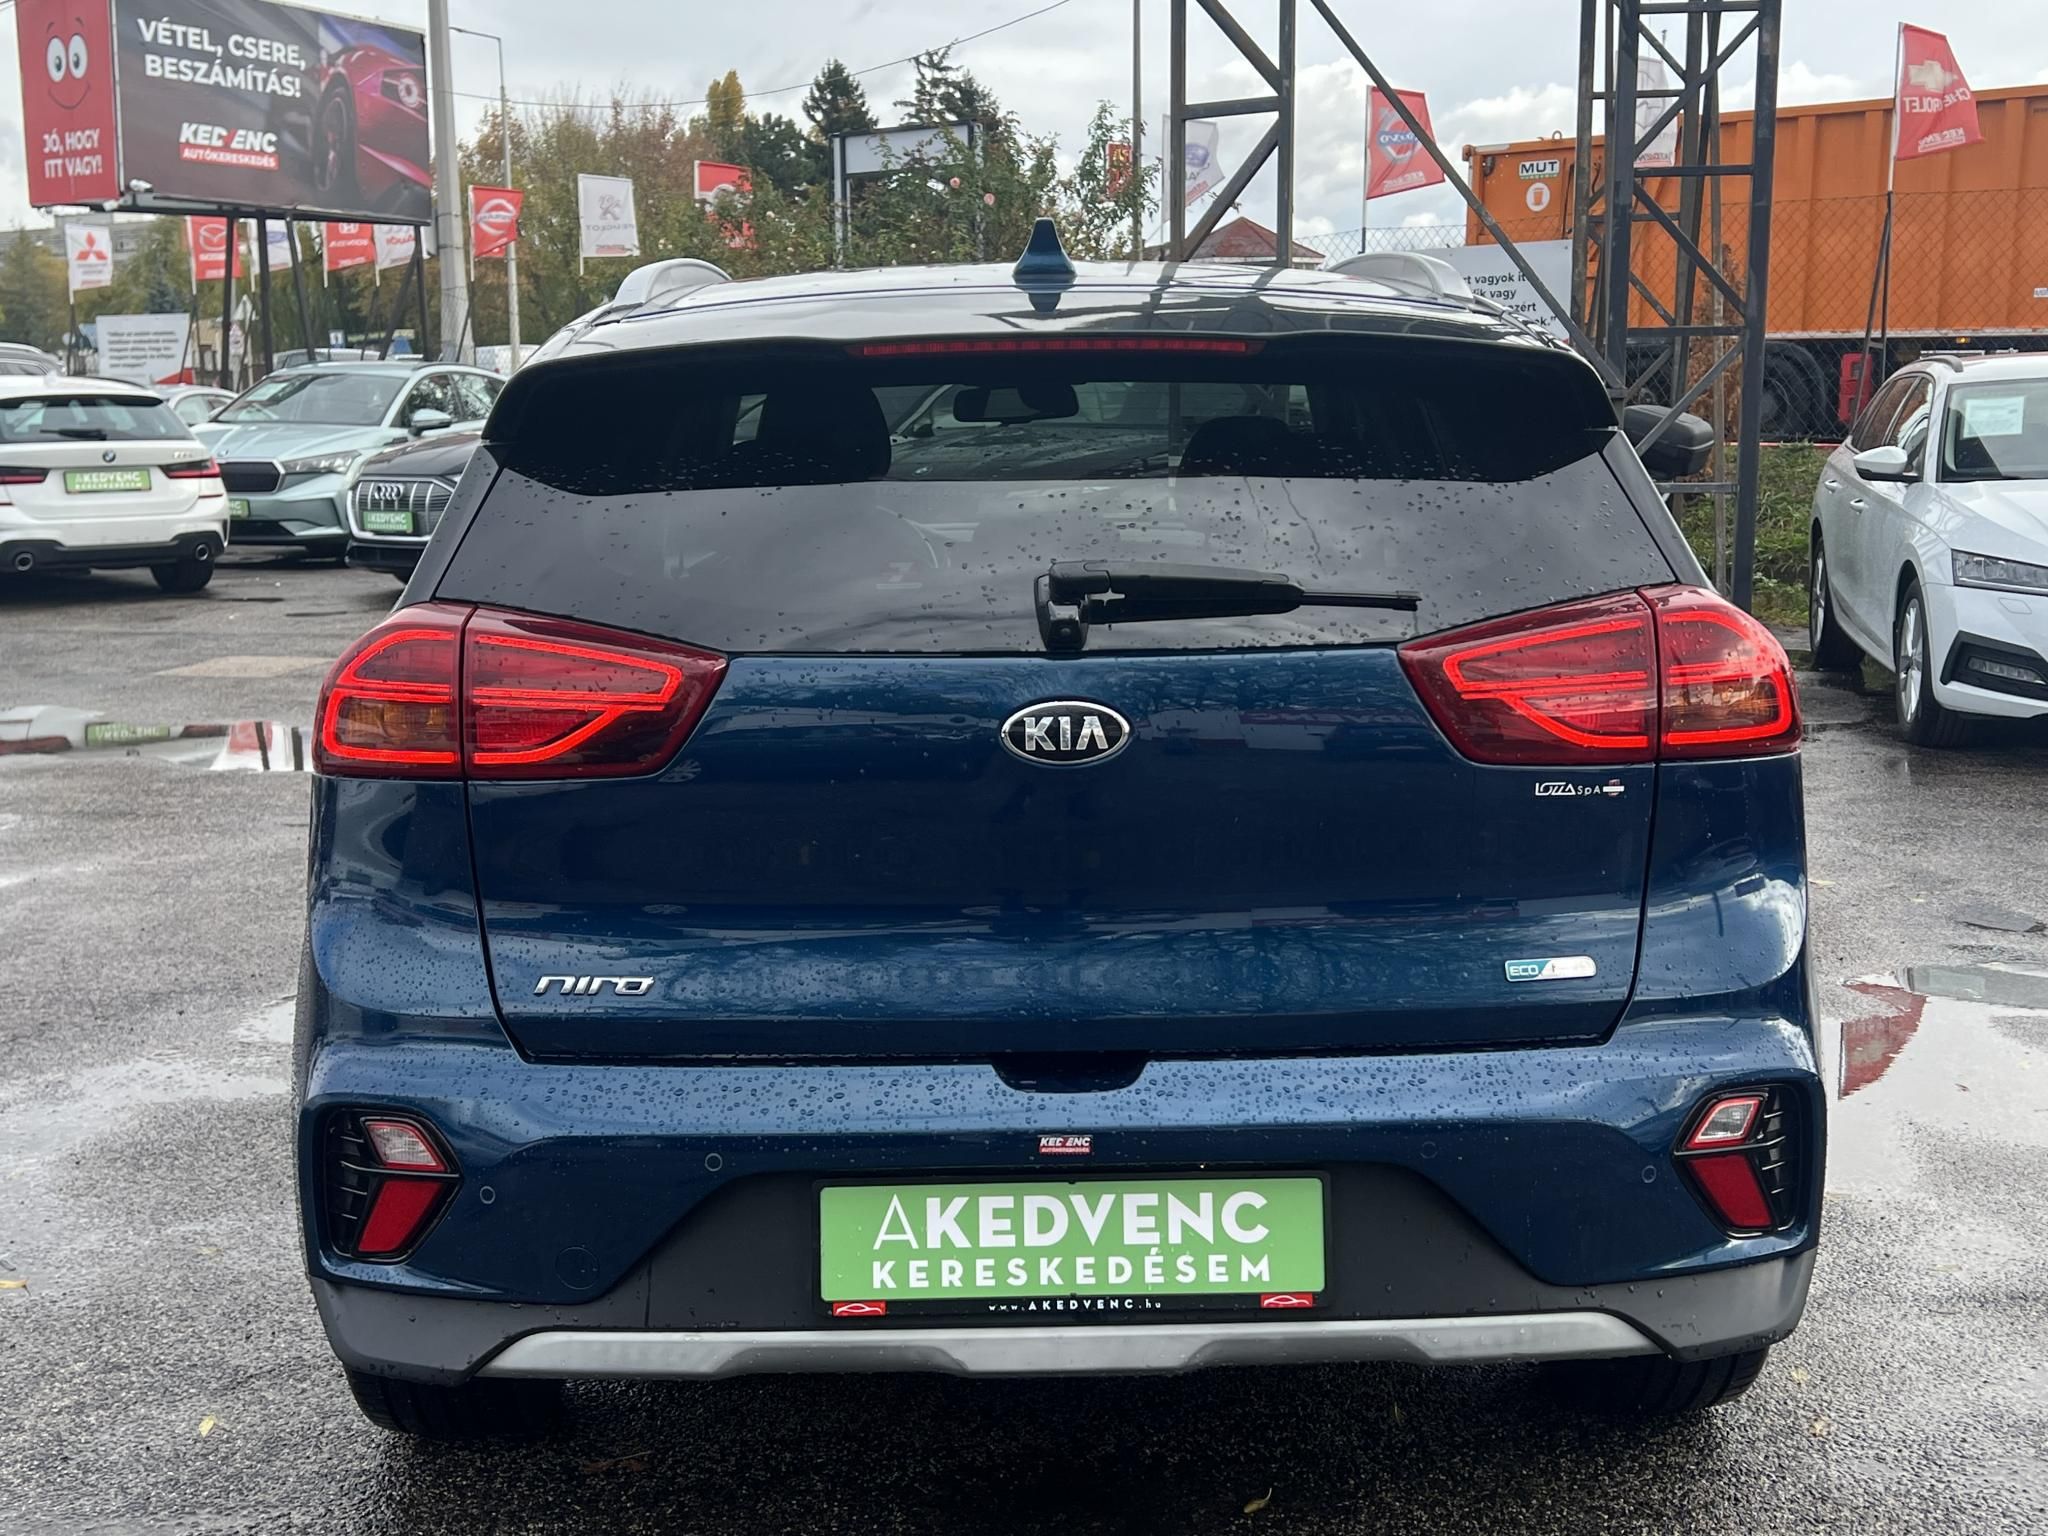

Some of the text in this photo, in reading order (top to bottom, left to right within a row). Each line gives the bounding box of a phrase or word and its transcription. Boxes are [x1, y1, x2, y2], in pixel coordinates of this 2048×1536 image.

[137, 17, 306, 71] VÉTEL, CSERE,
[145, 54, 301, 98] BESZÁMÍTÁS!
[43, 128, 100, 154] JÓ, HOGY
[44, 154, 103, 178] ITT VAGY!
[1520, 161, 1558, 174] MUT
[1475, 272, 1515, 286] vagyok
[1490, 289, 1517, 300] vagy
[1023, 715, 1109, 752] KIA
[872, 1247, 1271, 1290] KERESKEDÉSEM
